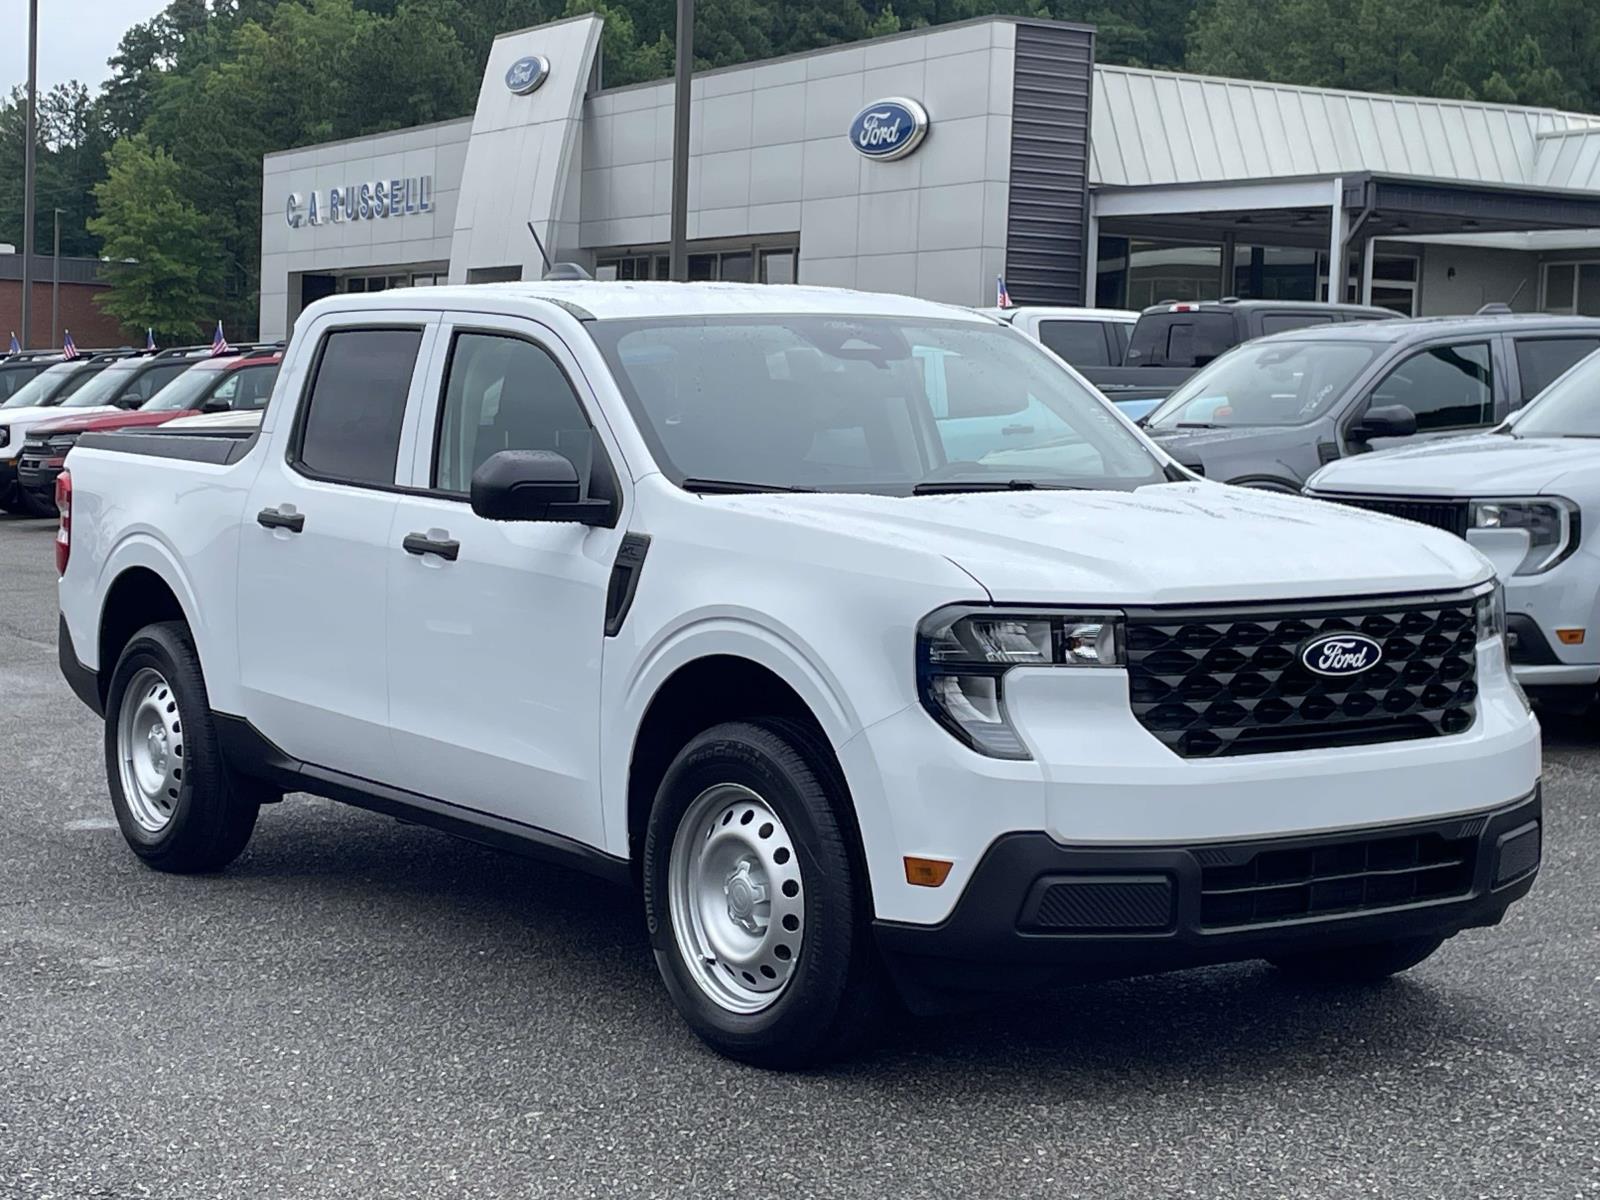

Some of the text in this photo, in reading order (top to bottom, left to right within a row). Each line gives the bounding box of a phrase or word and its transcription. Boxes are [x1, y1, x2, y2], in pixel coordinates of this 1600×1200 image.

[859, 111, 901, 147] Ford
[330, 175, 432, 223] RUSSELL
[1318, 641, 1368, 670] Ford
